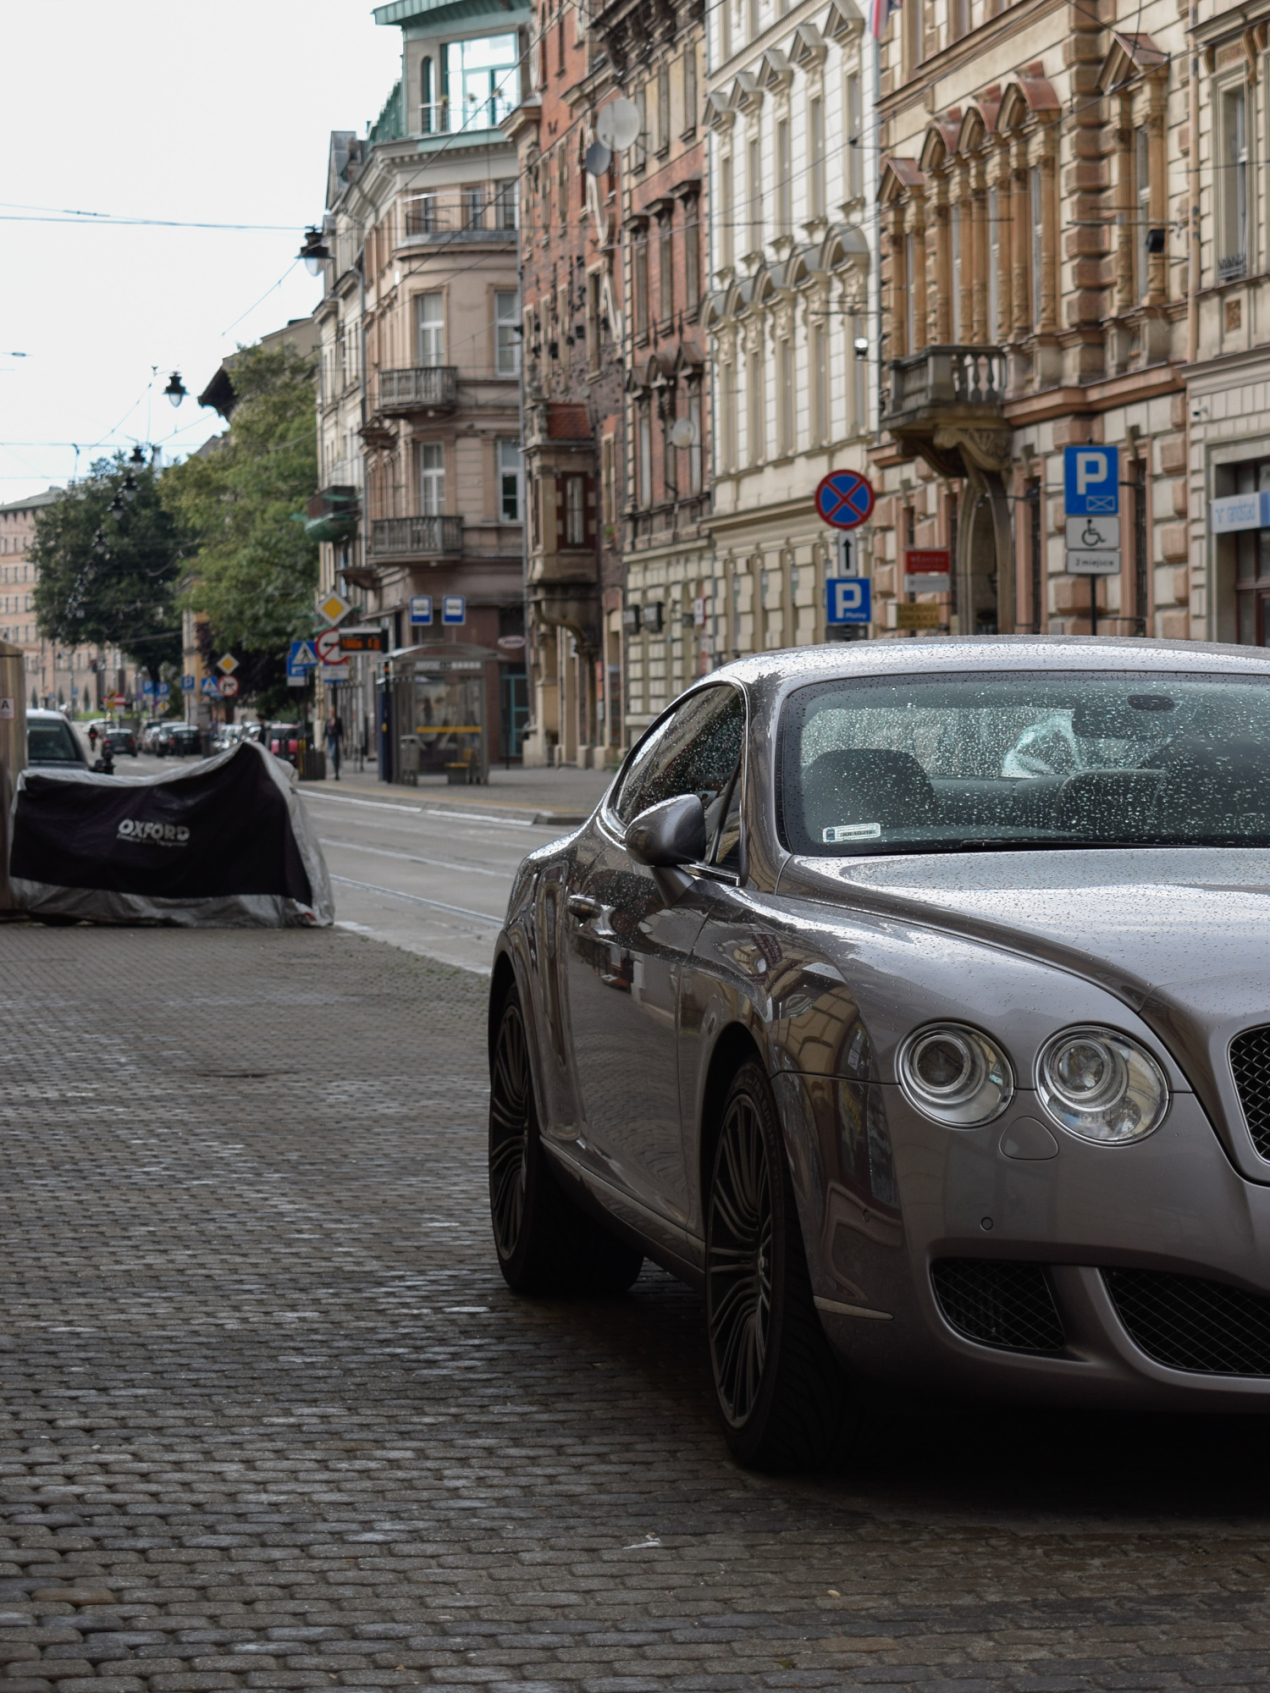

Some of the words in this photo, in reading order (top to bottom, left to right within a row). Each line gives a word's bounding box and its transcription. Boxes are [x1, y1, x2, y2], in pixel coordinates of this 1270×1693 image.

[1076, 452, 1107, 495] P
[835, 583, 862, 619] P
[118, 818, 190, 841] OXFORD
